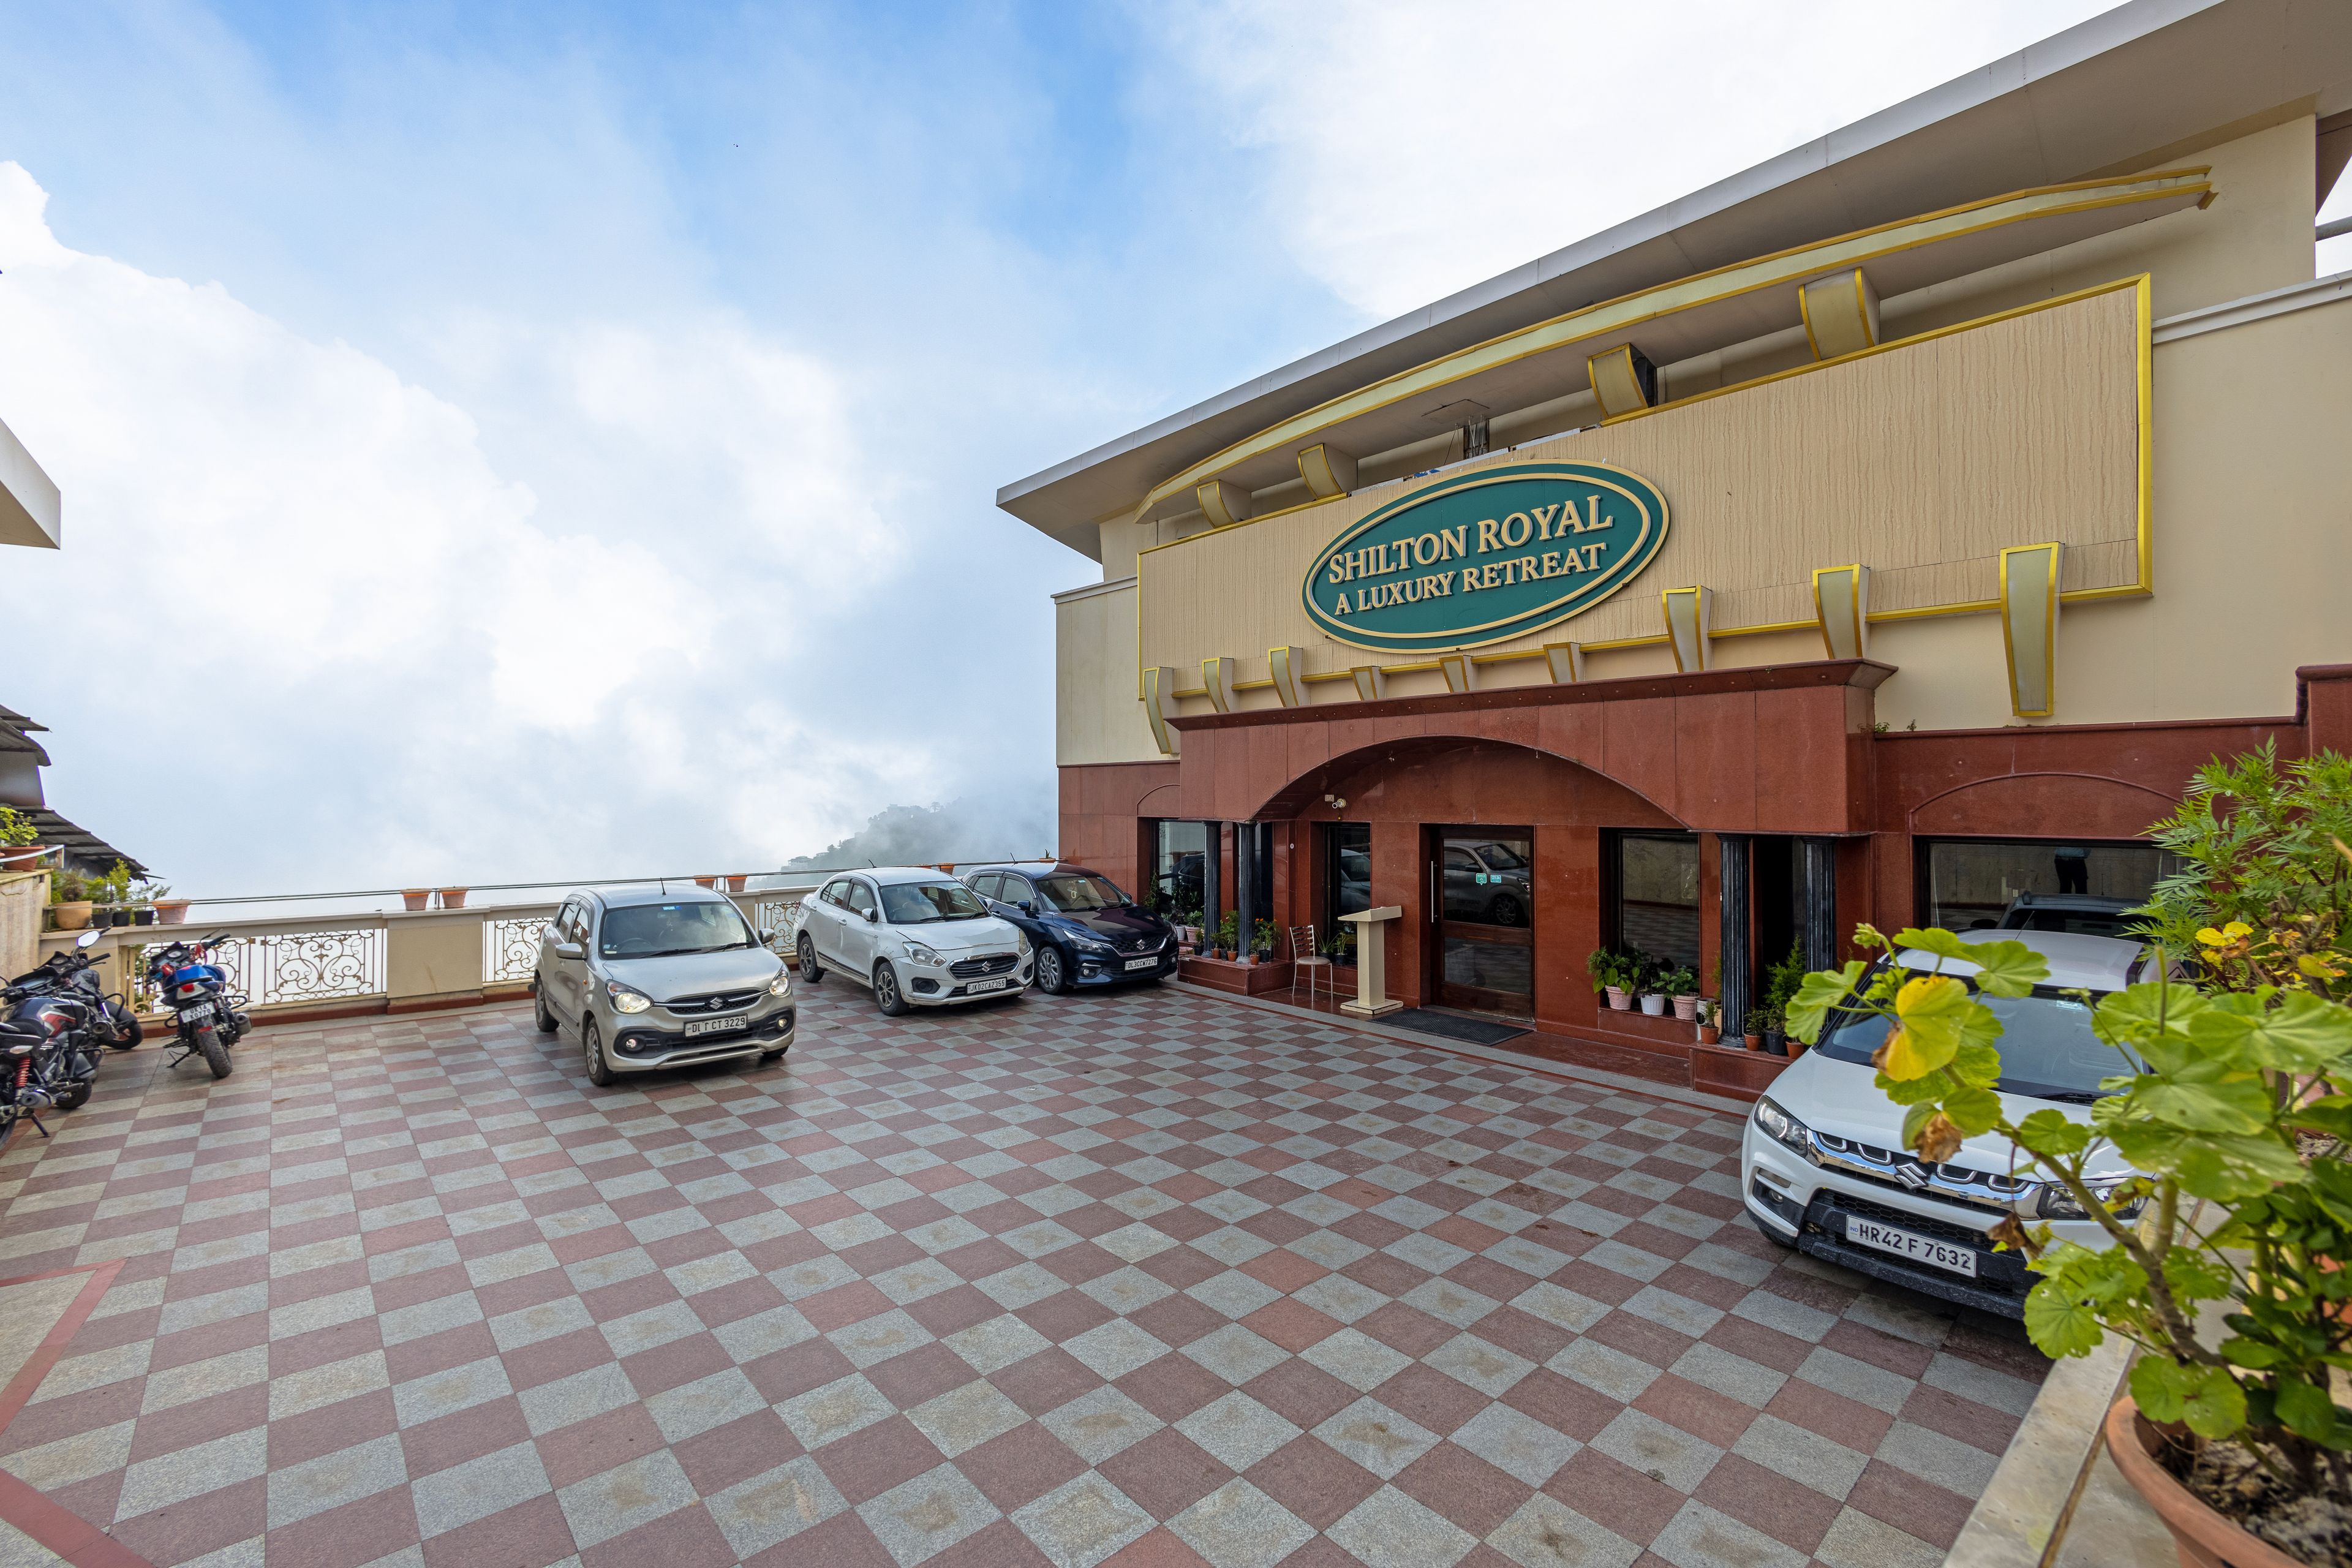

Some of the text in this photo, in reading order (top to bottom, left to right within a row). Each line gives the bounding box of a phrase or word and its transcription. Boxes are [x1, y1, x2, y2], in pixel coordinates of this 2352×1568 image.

[1329, 494, 1614, 584] SHILTON ROYAL
[1334, 542, 1607, 616] A LUXURY RETREAT
[971, 979, 1005, 991] JK02CA2355
[724, 1017, 745, 1028] 3229
[1860, 1224, 1972, 1270] HR42 F 7632
